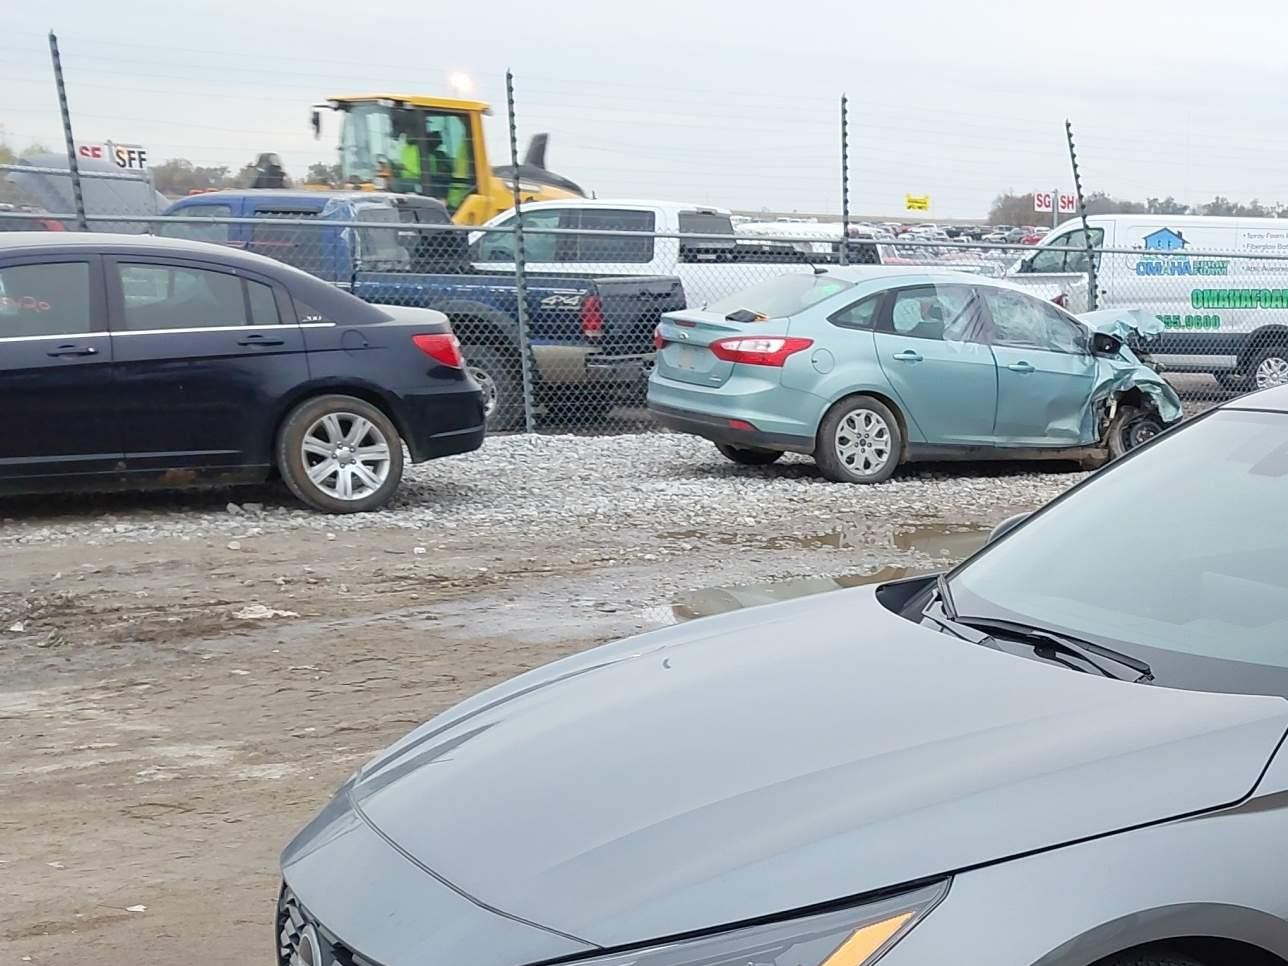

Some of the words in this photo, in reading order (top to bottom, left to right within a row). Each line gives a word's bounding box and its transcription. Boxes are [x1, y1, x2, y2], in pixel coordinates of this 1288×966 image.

[116, 150, 146, 168] SFF
[1036, 193, 1051, 208] SG
[1060, 195, 1075, 210] SH
[1136, 261, 1192, 276] OMAHA
